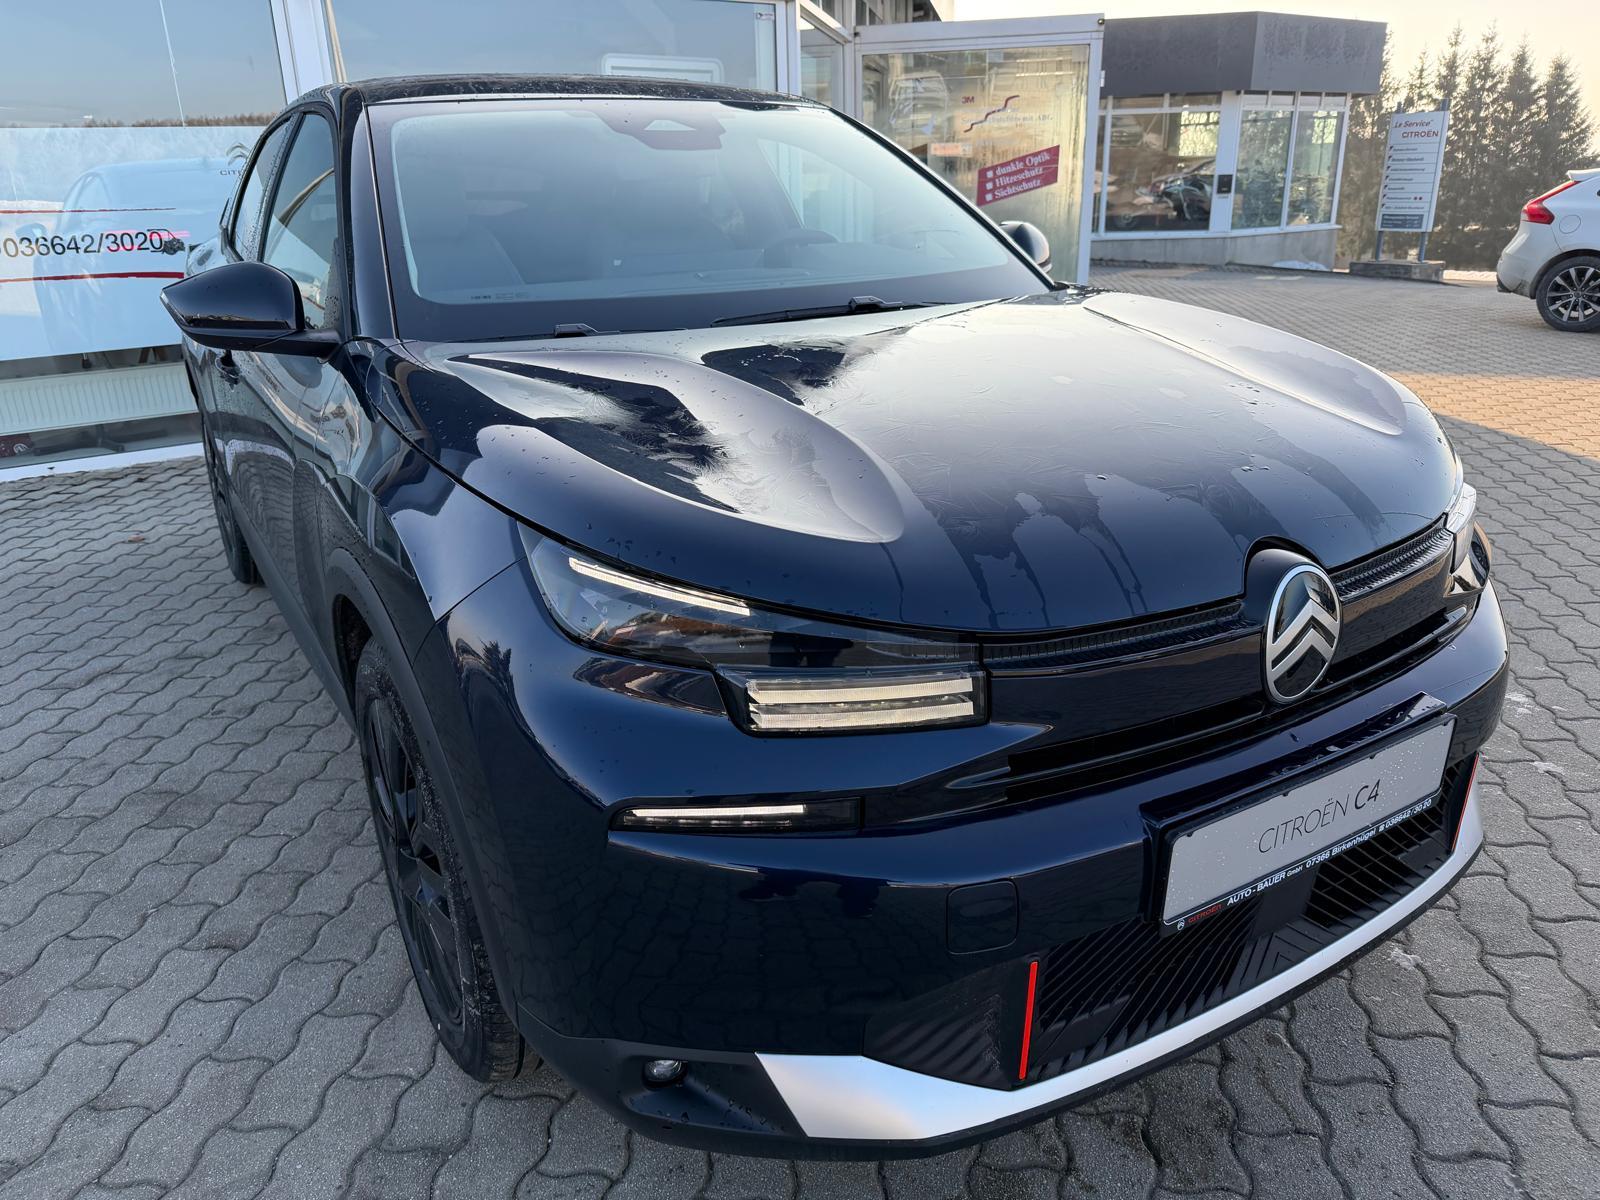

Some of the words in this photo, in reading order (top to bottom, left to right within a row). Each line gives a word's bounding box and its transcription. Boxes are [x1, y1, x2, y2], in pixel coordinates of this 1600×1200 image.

[961, 96, 975, 104] 3M
[1403, 119, 1431, 128] Service
[995, 162, 1024, 176] dunkle
[1025, 151, 1051, 167] Optik
[995, 167, 1043, 187] Hitzeschutz
[993, 179, 1042, 200] Sichtschutz
[1258, 793, 1350, 854] CITROËN
[1354, 779, 1381, 810] C4
[1227, 888, 1253, 906] AUTO
[1286, 864, 1304, 878] GmbH
[1305, 850, 1331, 869] 07366
[1331, 829, 1377, 857] Birkenhügel
